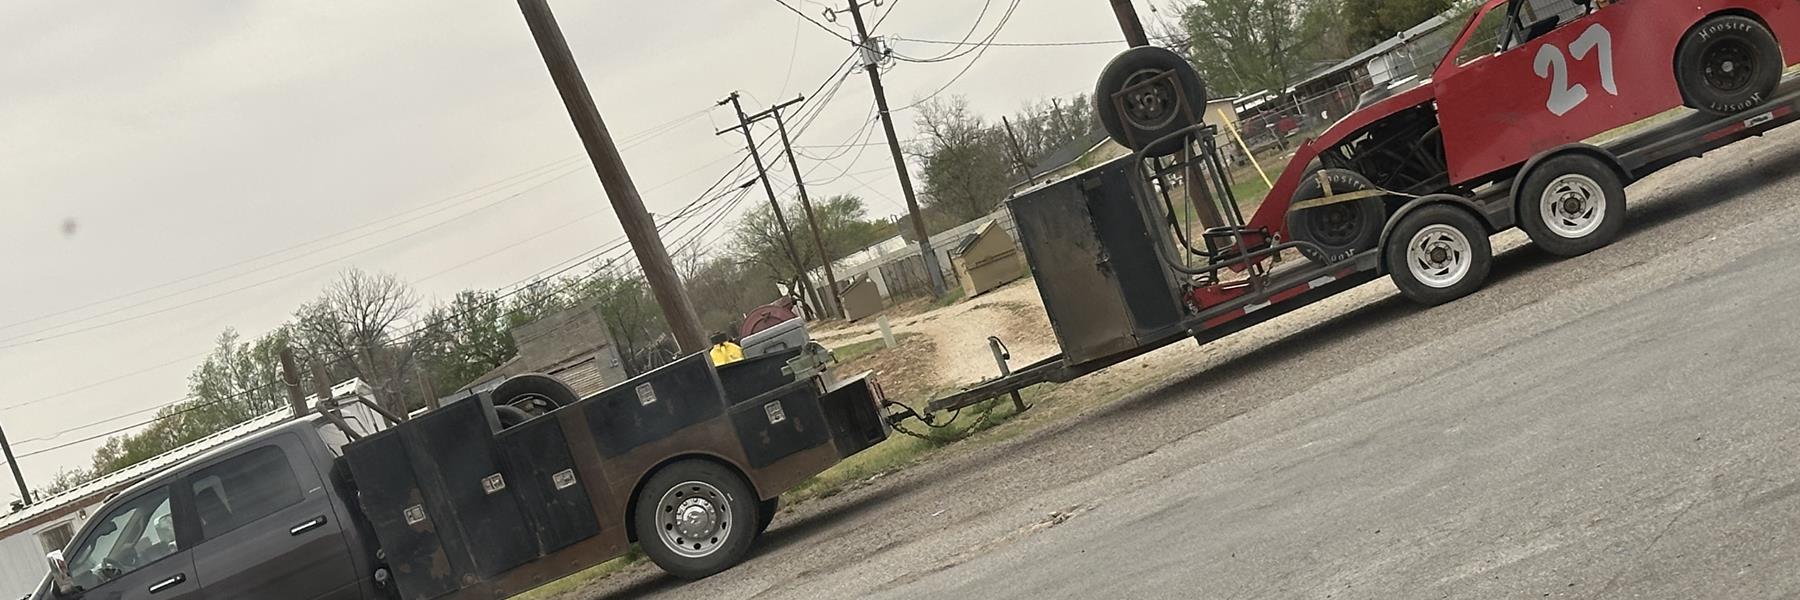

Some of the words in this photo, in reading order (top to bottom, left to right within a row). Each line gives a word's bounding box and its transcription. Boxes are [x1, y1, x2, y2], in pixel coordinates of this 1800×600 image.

[1699, 22, 1752, 40] Hoosier
[1533, 23, 1618, 116] 27
[1711, 92, 1761, 111] Hoosier
